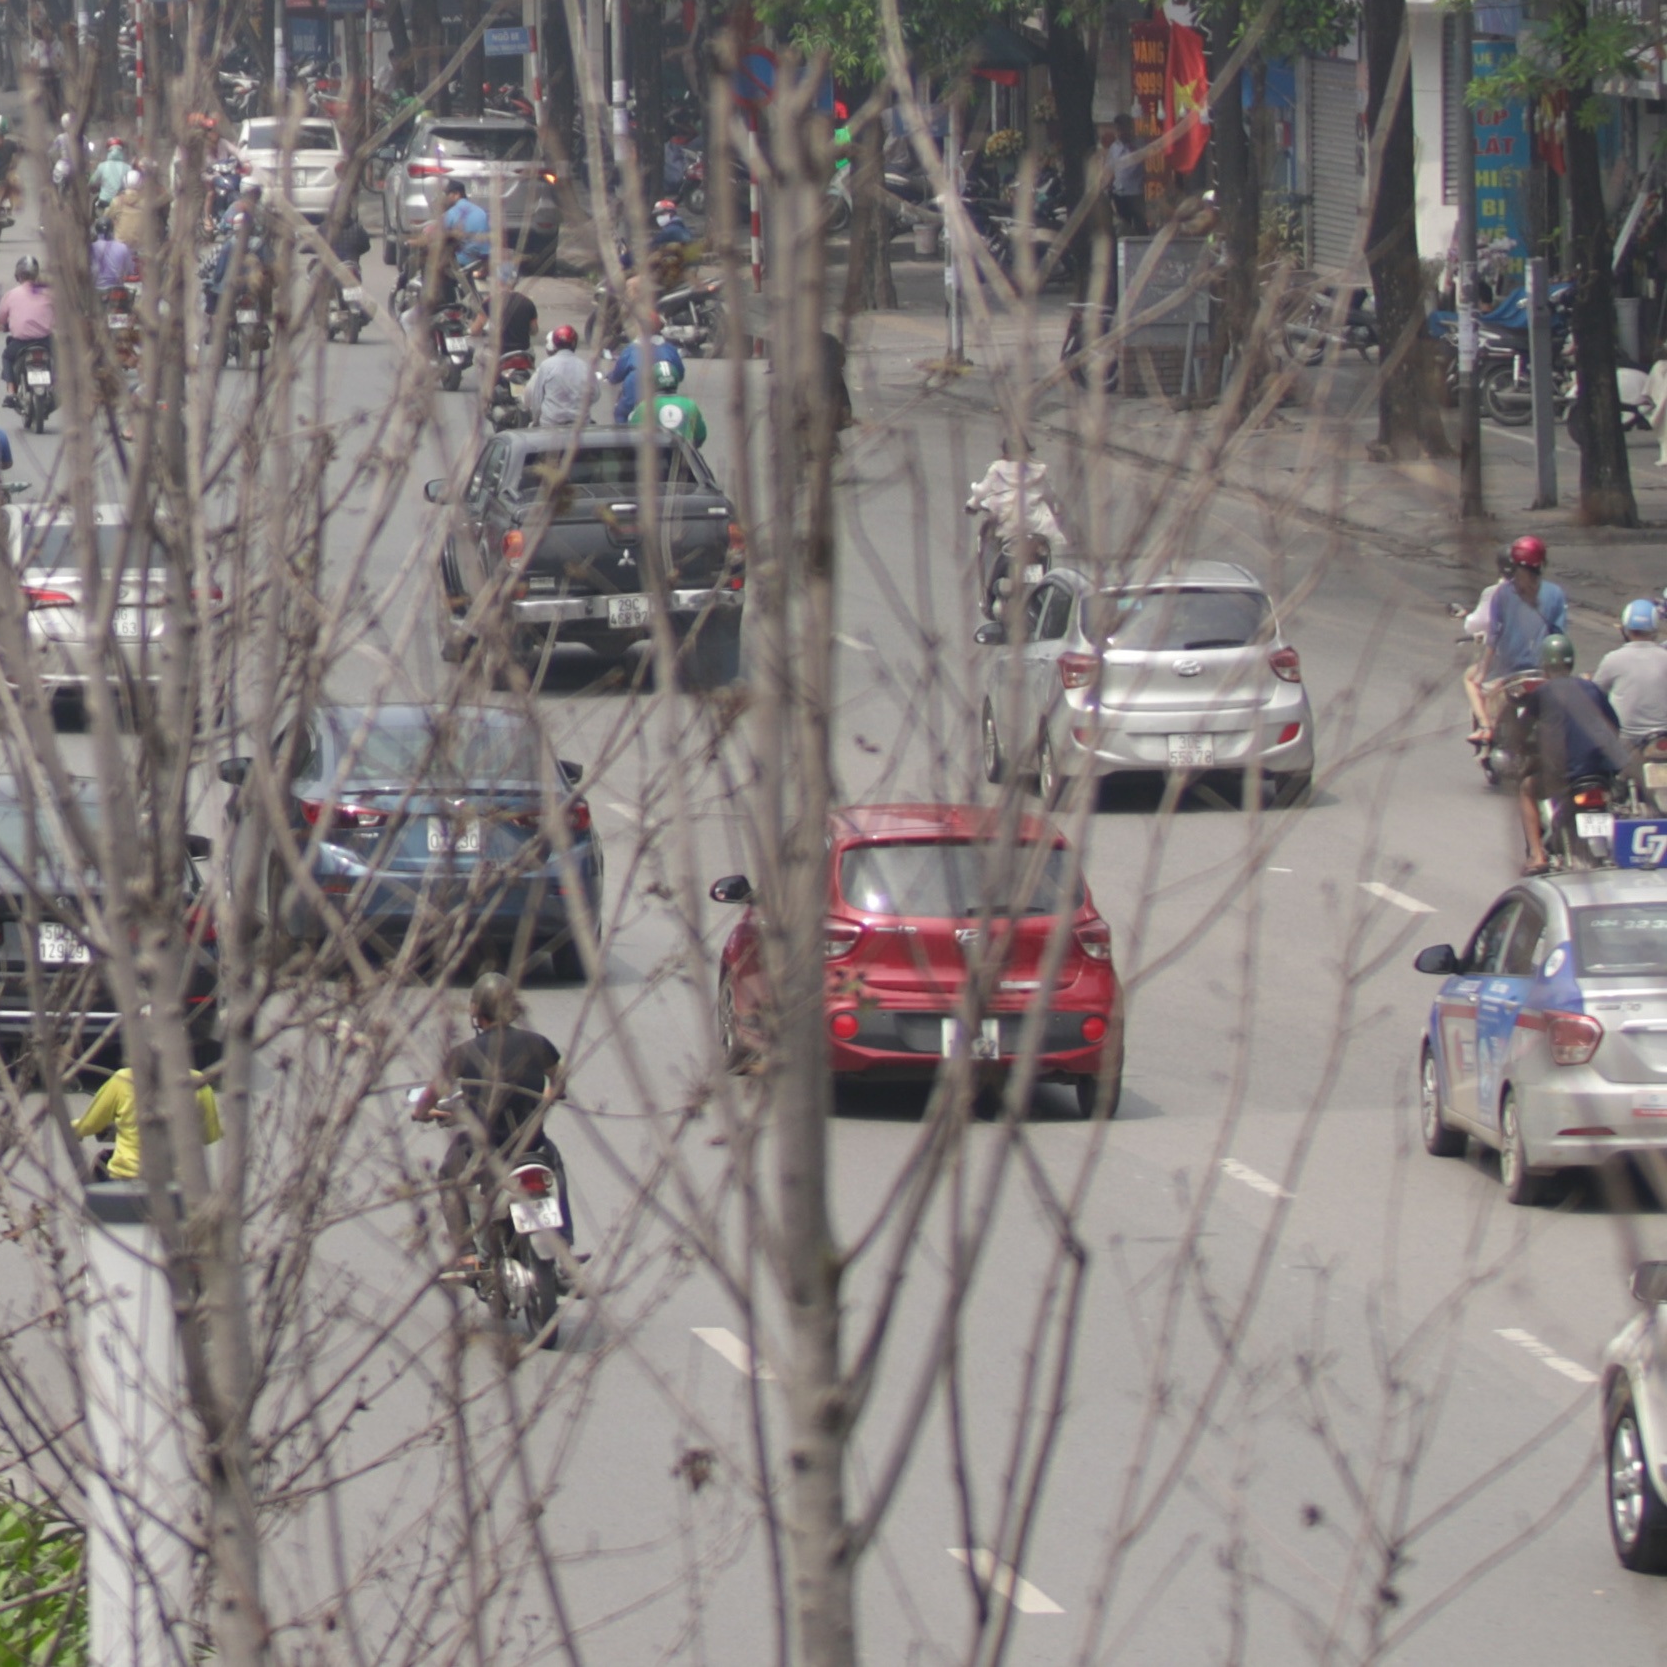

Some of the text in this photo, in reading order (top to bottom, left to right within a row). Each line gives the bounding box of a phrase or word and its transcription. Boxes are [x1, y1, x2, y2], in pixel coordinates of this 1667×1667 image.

[1132, 36, 1165, 64] VÀNG
[1134, 72, 1164, 94] 9999
[1481, 199, 1506, 222] BỊ
[618, 599, 639, 612] 29C
[1632, 825, 1667, 863] G7
